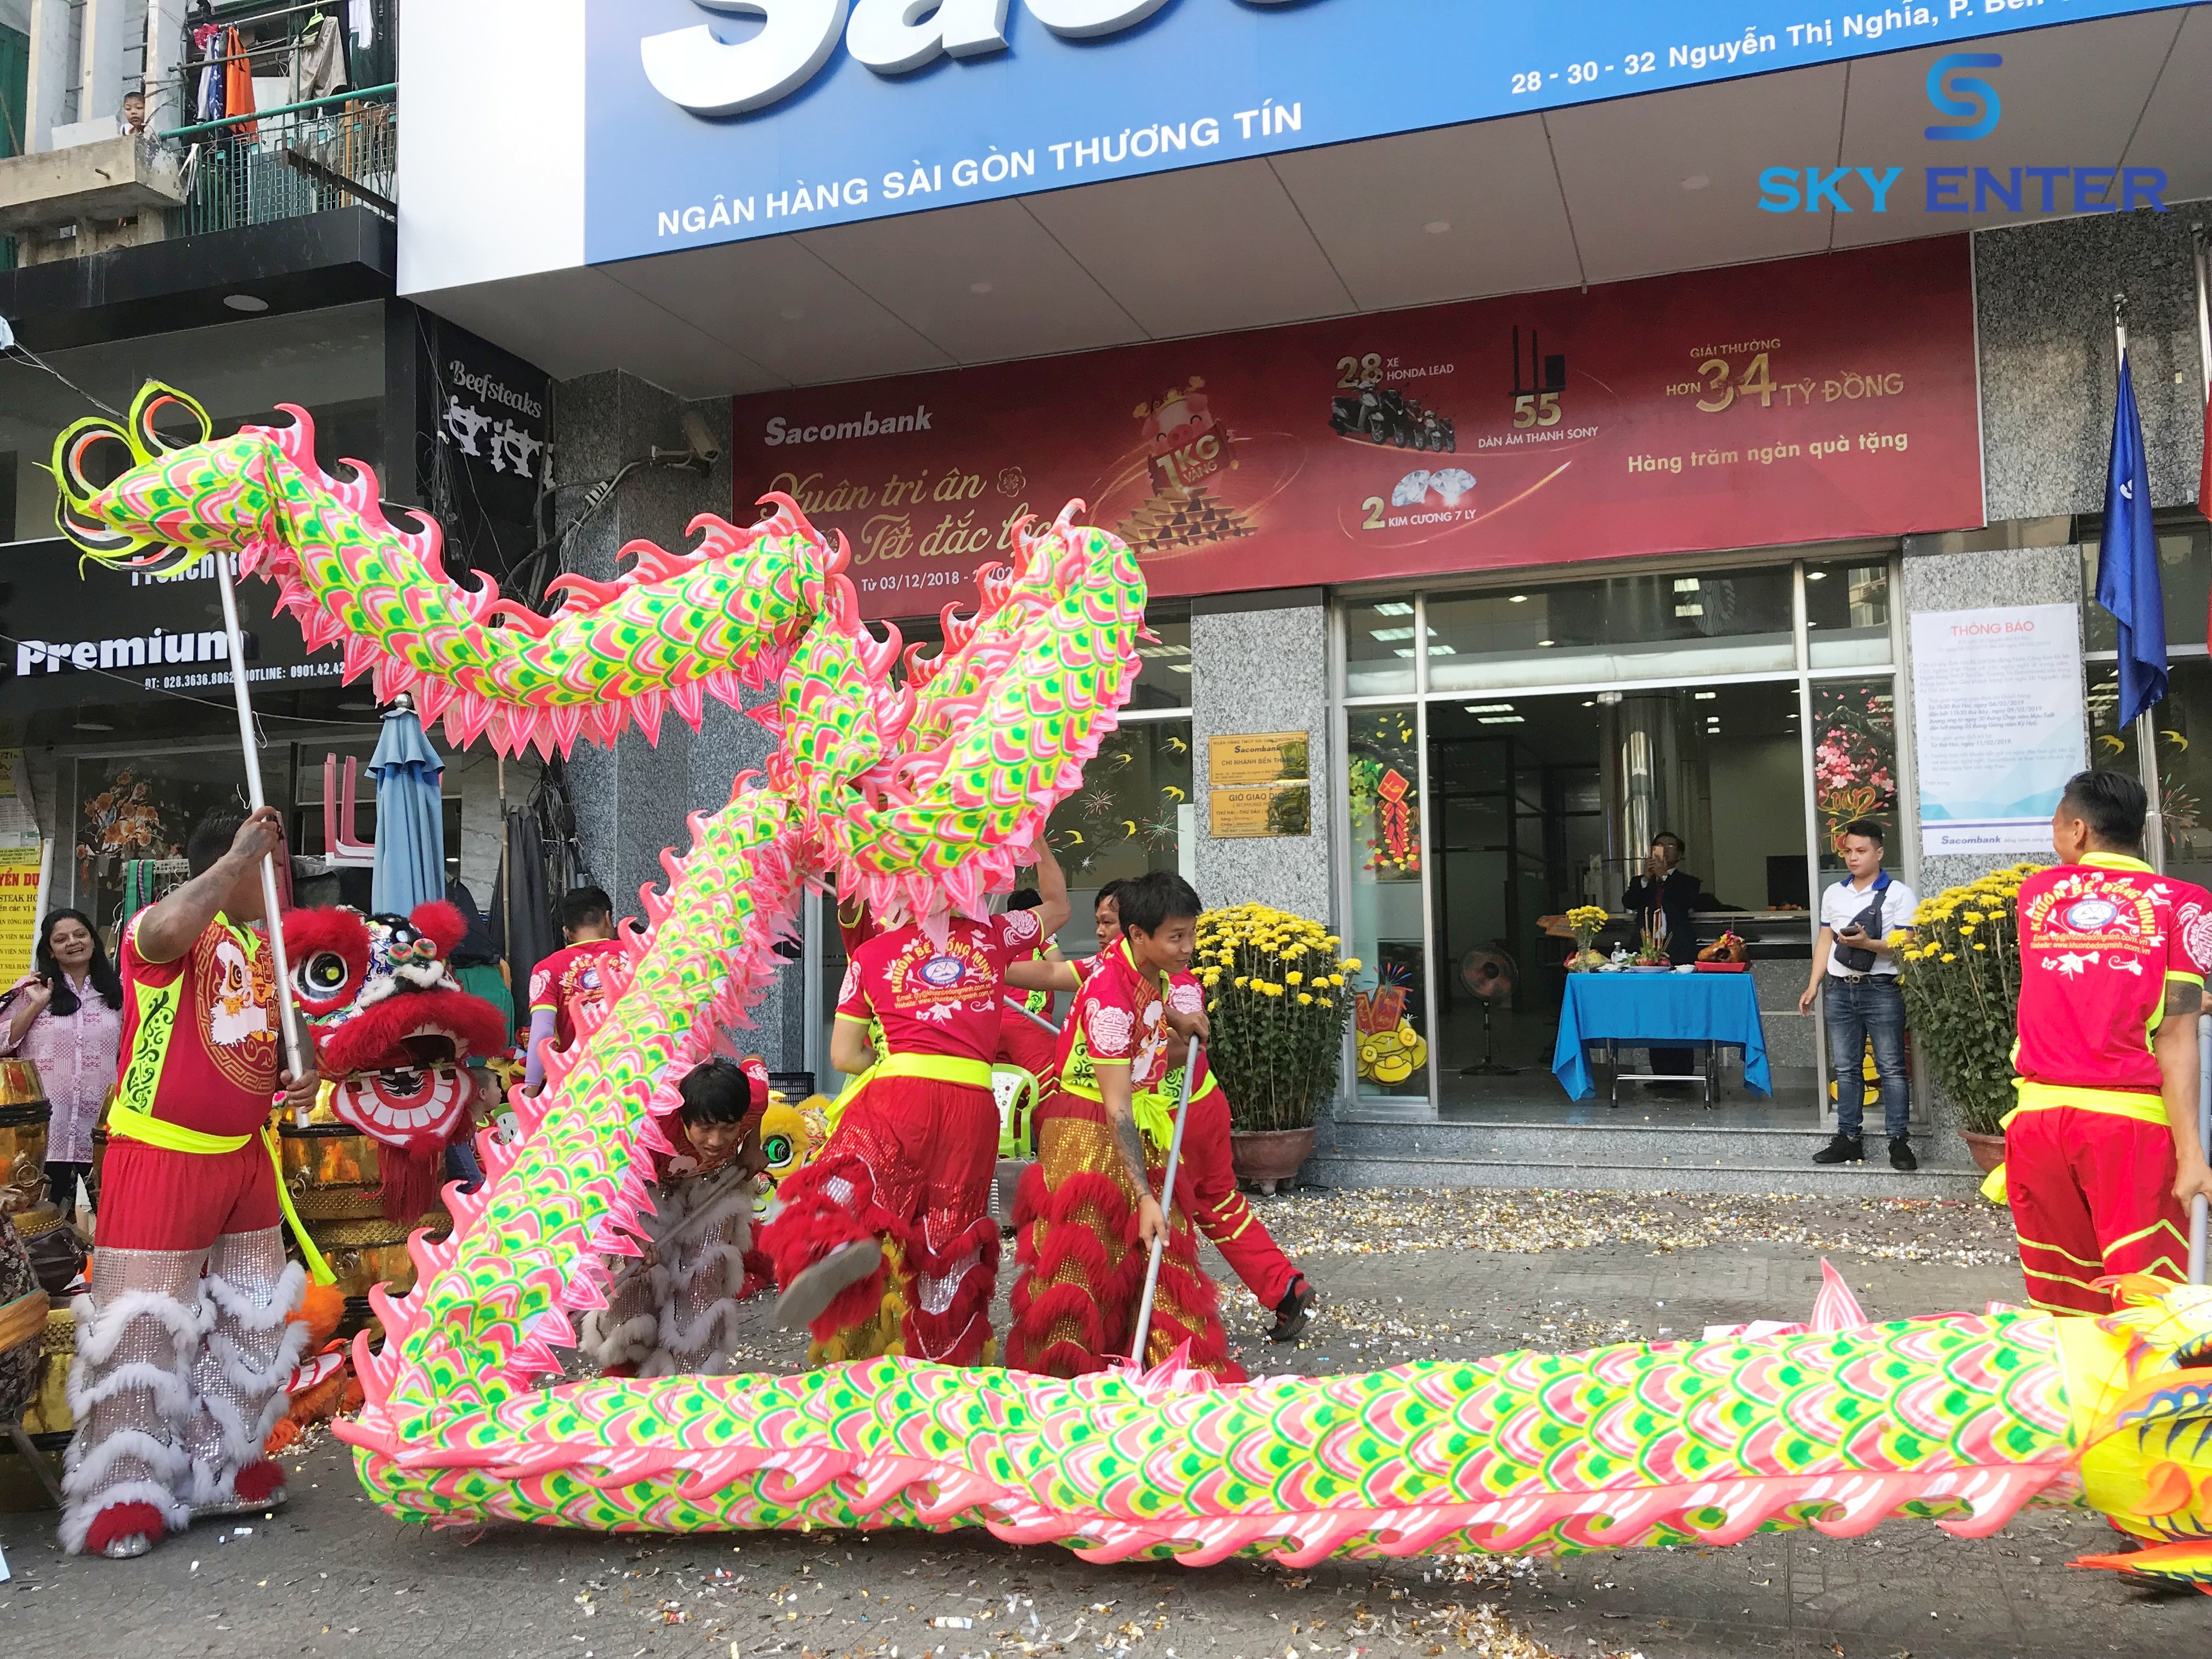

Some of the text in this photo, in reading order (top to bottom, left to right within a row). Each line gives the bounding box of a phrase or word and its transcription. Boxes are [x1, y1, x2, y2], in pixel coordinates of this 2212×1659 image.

[1511, 70, 1542, 95] 28
[1567, 61, 1599, 86] 30
[1625, 53, 1656, 77] 32
[1668, 26, 1776, 69] Nguyễn
[1786, 21, 1834, 47] Thị
[1843, 0, 1939, 42] Nghĩa,
[657, 98, 1303, 237] NGÂN HÀNG SÀI GÒN THƯƠNG TÍN
[1690, 337, 1782, 359] GIẢI THƯỞNG
[1336, 352, 1400, 389] 28 XE
[1386, 364, 1454, 381] HONDA LEAD
[1666, 352, 1904, 413] HƠN 34 TỶ ĐỒNG
[450, 360, 542, 419] Beefsteaks
[764, 405, 933, 446] Sacombank
[1512, 392, 1562, 430] 55
[1478, 425, 1599, 449] DÀN ÂM THANH SONY
[1628, 430, 1909, 476] Hàng trăm ngàn quà tặng
[884, 469, 933, 507] tri
[933, 467, 991, 503] ân
[1182, 461, 1218, 484] VÀNG
[1361, 496, 1477, 530] 2 KIM CƯƠNG 7 LY
[854, 512, 916, 566] Tết
[919, 509, 992, 557] đắc
[862, 577, 878, 592] Từ
[880, 571, 960, 590] 03/12/2018
[1951, 618, 2035, 637] THÔNG BÁO
[17, 628, 244, 676] Premium
[163, 671, 235, 689] 028.3636.8062
[290, 662, 346, 679] 0901.42.42
[1234, 745, 1282, 753] Sacombank
[1228, 792, 1244, 802] GIỜ
[1941, 835, 2001, 844] Sacombank
[2030, 888, 2067, 932] KHUÔN
[2100, 881, 2142, 899] ĐỒNG
[2134, 898, 2156, 935] MINH
[891, 953, 915, 993] KHUÔN
[972, 950, 992, 981] MINH
